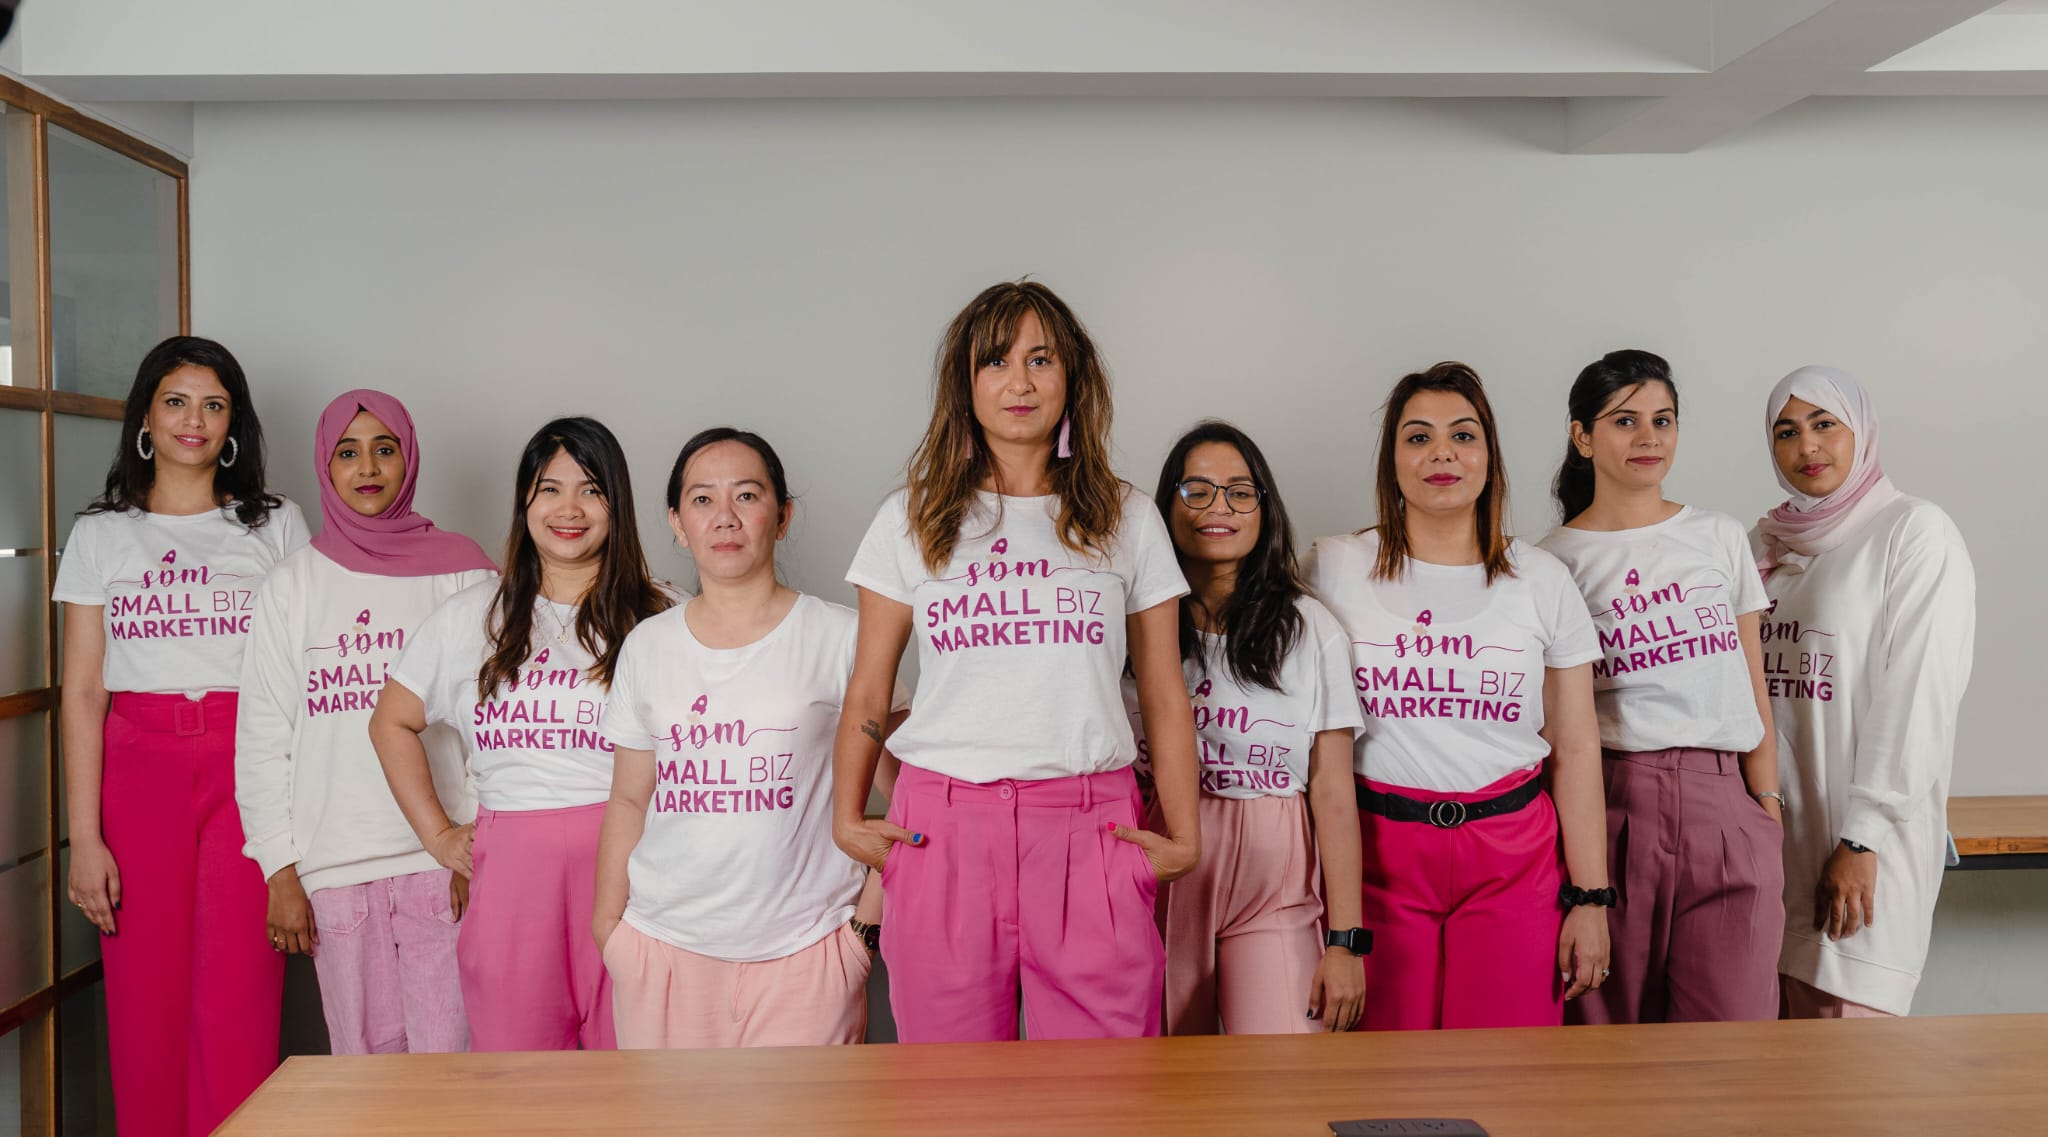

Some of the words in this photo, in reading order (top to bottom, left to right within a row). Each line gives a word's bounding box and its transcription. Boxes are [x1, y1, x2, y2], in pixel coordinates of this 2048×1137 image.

[111, 593, 201, 617] SMALL
[213, 590, 254, 612] BIZ
[927, 588, 1041, 628] SMALL
[1056, 587, 1105, 616] BIZ
[111, 615, 252, 640] MARKETING
[930, 619, 1105, 656] MARKETING
[1599, 615, 1688, 653] MALL
[1694, 603, 1735, 630] BIZ
[1592, 630, 1739, 679] MARKETING
[1799, 652, 1835, 678] BIZ
[1355, 666, 1465, 693] SMALL
[1480, 670, 1526, 698] BIZ
[1765, 679, 1834, 701] ETING
[474, 699, 565, 726] SMALL
[576, 700, 608, 726] BI
[1360, 696, 1522, 723] MARKETING
[475, 728, 616, 753] MARKETING
[657, 759, 737, 784] MALL
[750, 753, 794, 783] BIZ
[1247, 744, 1292, 768] BIZ
[1199, 769, 1291, 792] KETING
